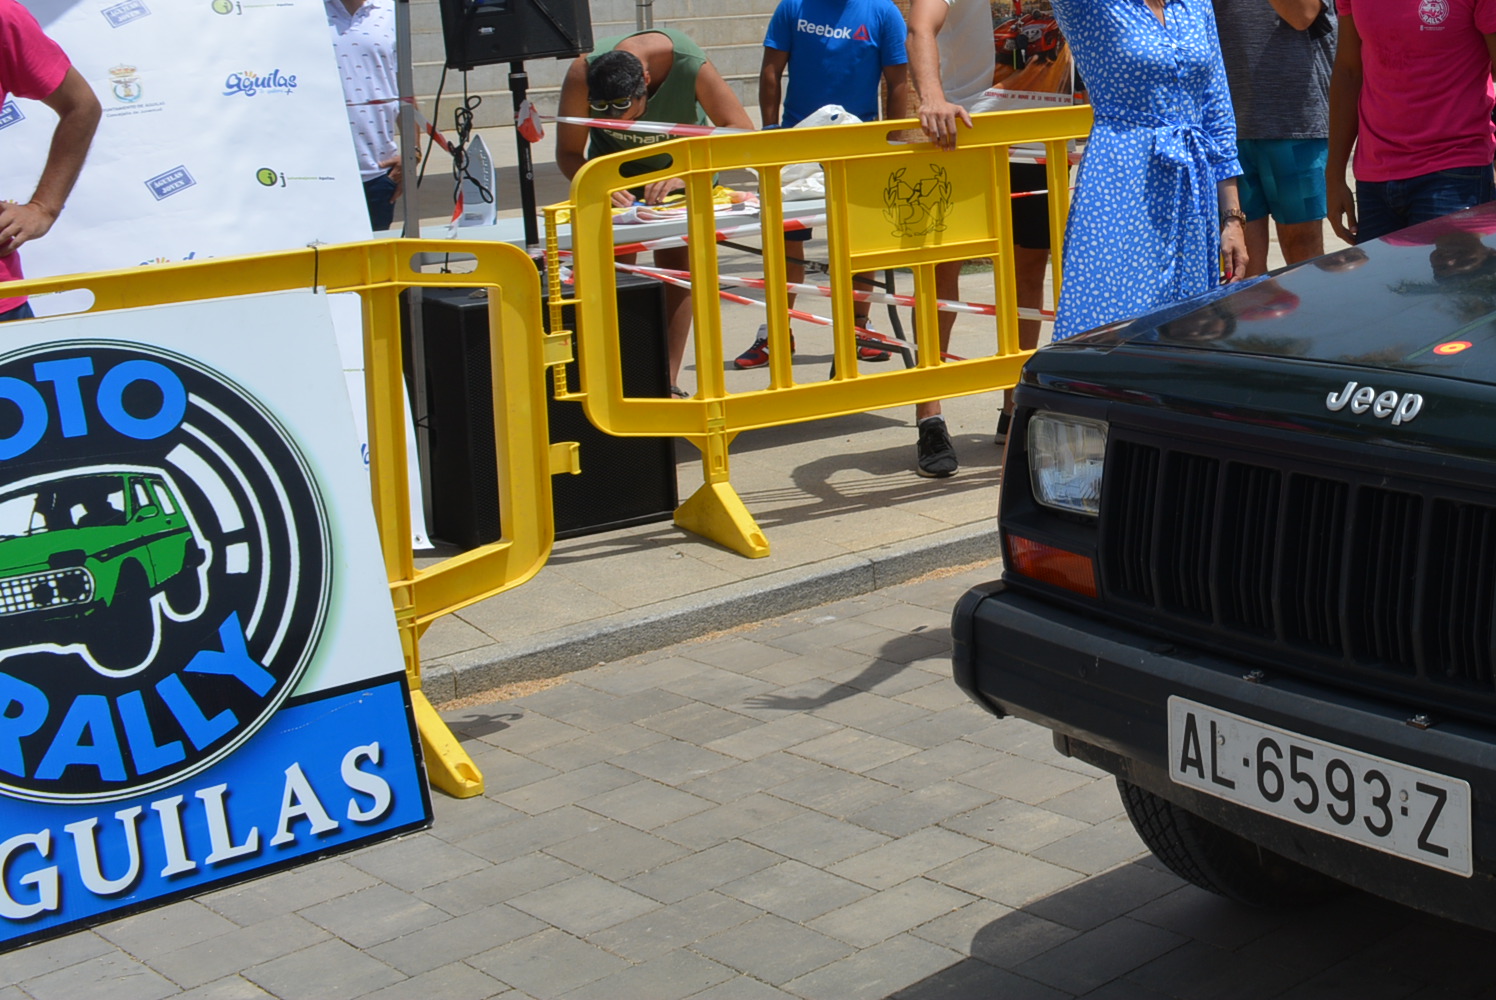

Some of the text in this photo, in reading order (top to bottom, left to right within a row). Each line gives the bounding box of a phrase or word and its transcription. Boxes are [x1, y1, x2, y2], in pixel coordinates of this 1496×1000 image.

[797, 18, 852, 39] Reebok
[1326, 381, 1423, 425] Jeep
[0, 610, 277, 782] RALLY
